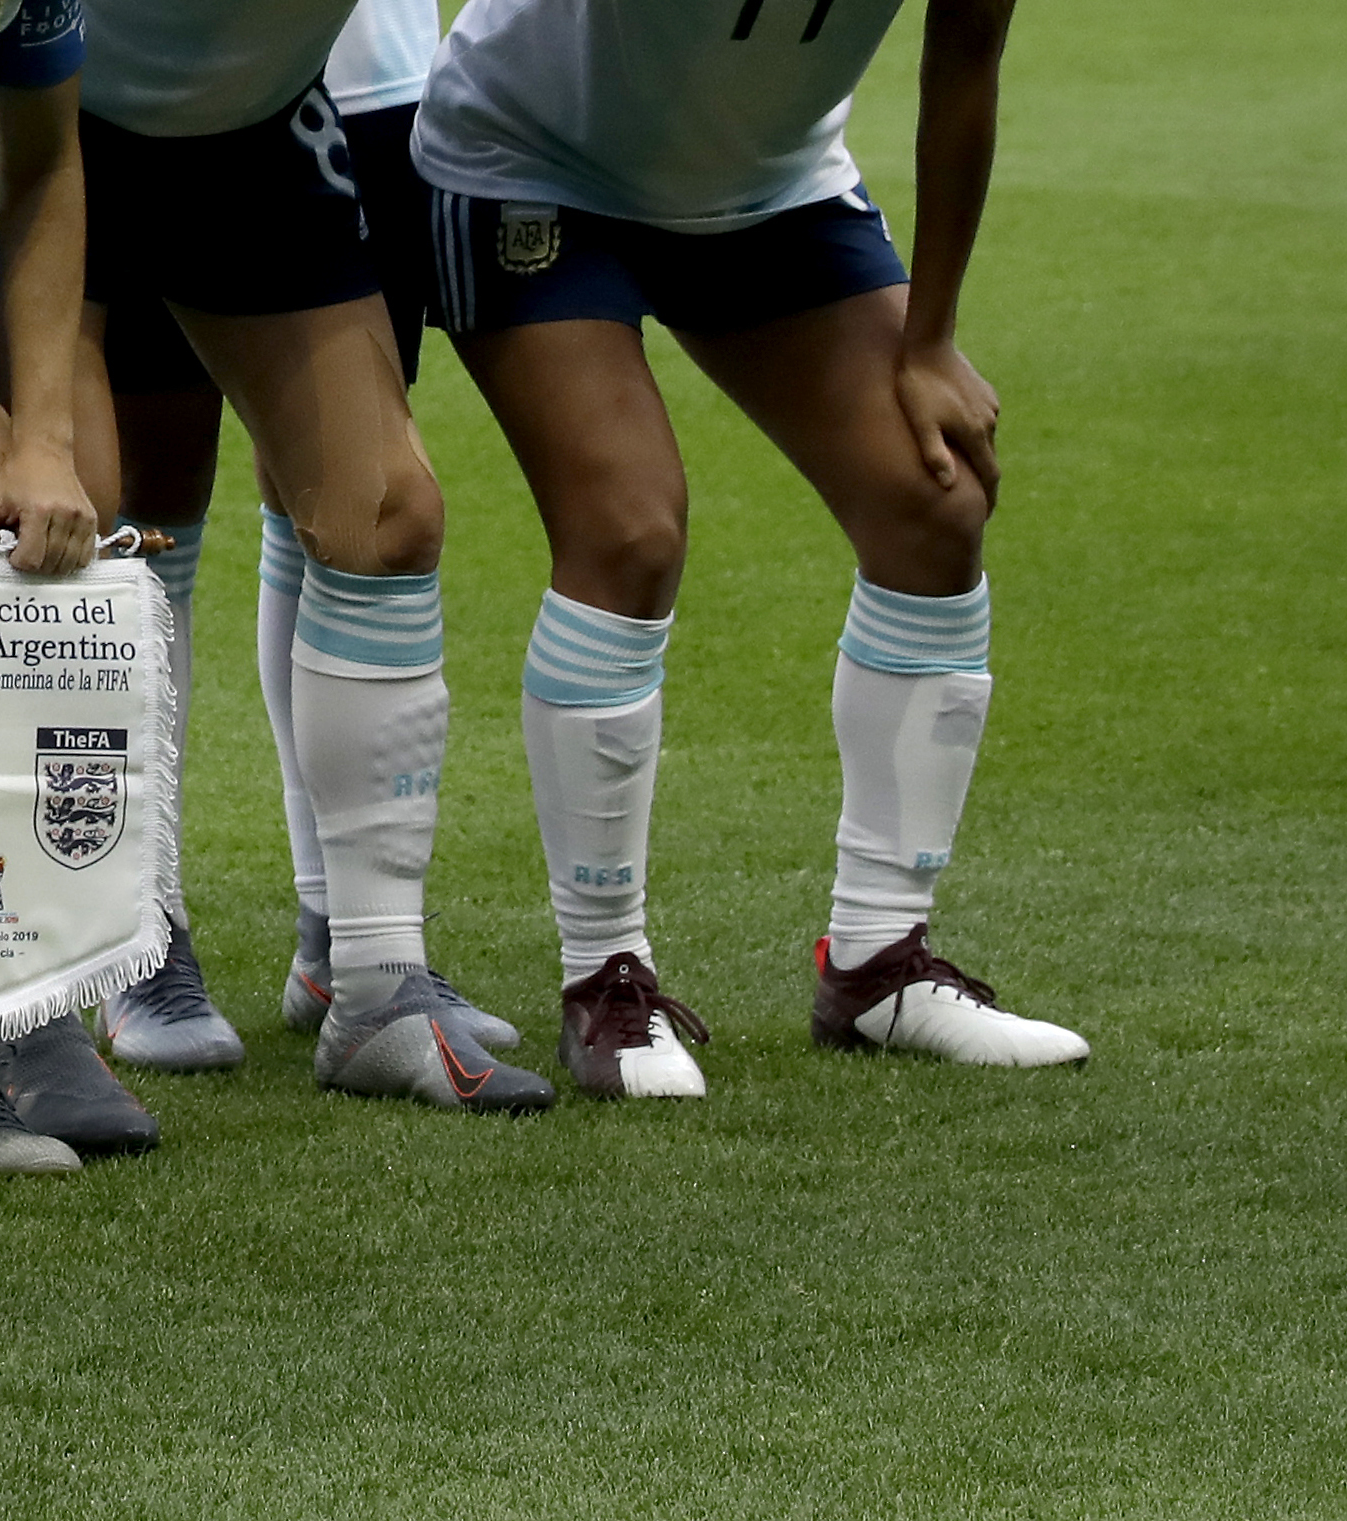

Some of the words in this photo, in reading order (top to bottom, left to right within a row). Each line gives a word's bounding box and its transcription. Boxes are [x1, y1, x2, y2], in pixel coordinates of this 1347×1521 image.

[73, 598, 116, 625] del
[59, 668, 75, 691] de
[78, 668, 92, 691] la
[53, 730, 112, 749] TheFA
[12, 931, 38, 941] 2019
